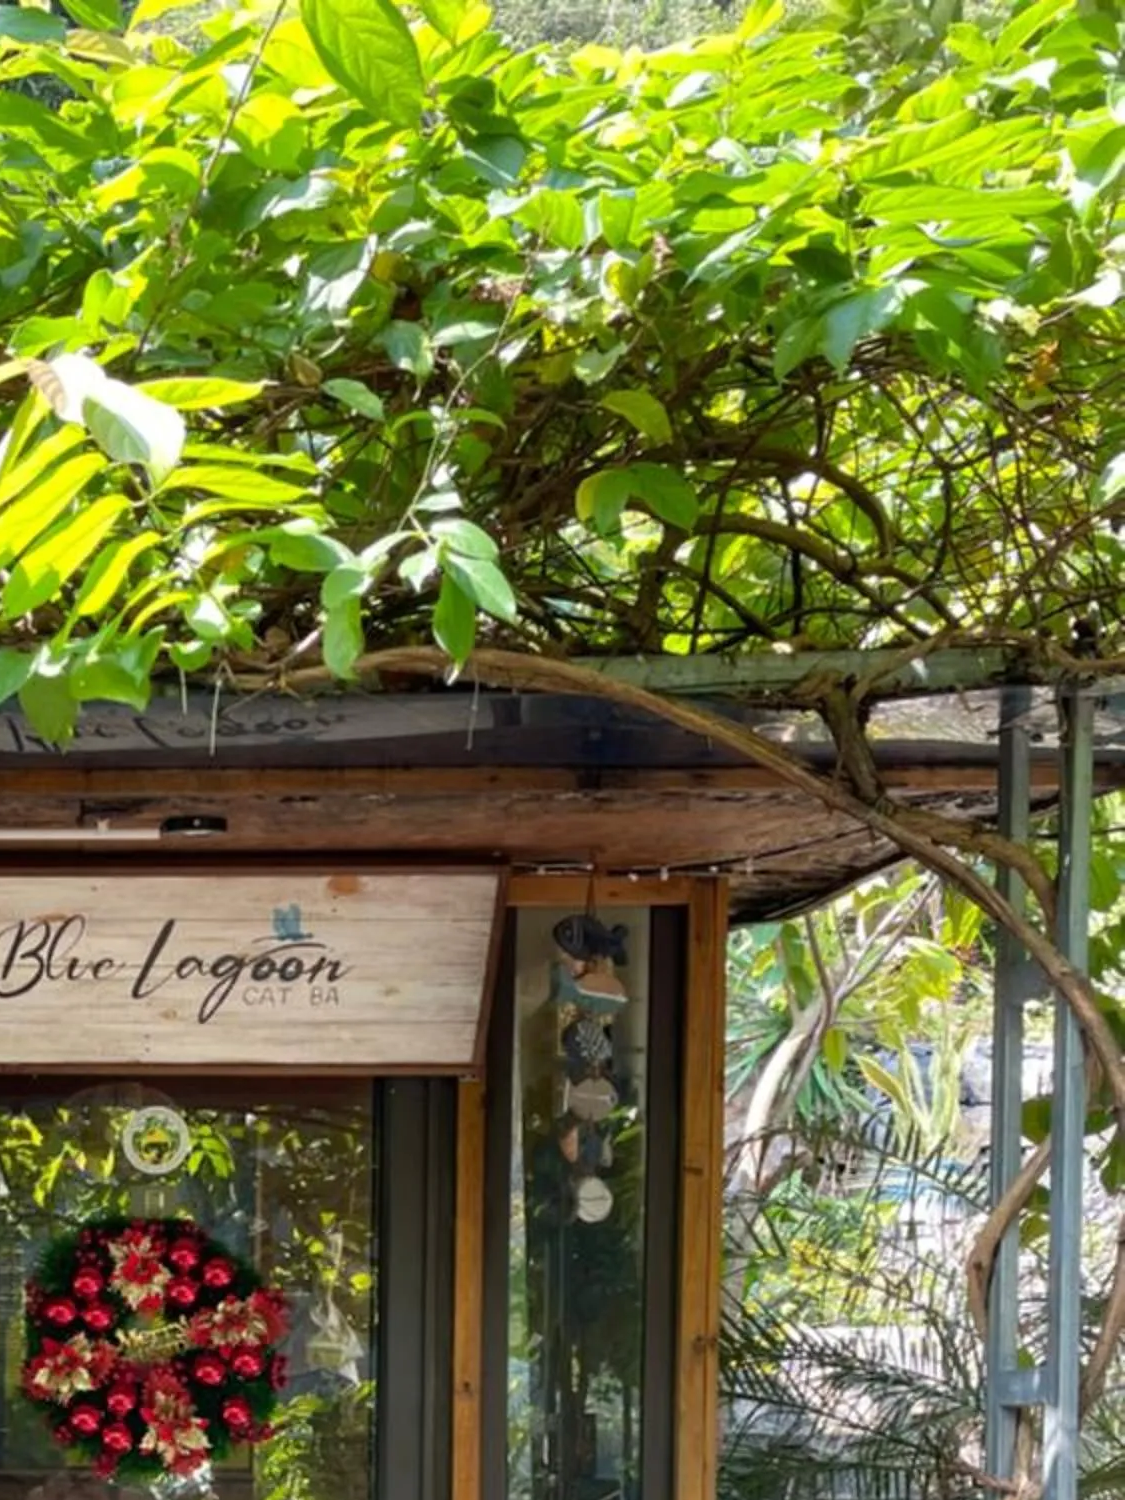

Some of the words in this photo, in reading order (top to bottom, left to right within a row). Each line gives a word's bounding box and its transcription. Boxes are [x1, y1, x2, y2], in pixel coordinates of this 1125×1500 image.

[130, 917, 352, 1025] Lagoon
[242, 988, 291, 1006] CAT
[308, 987, 340, 1006] BA
